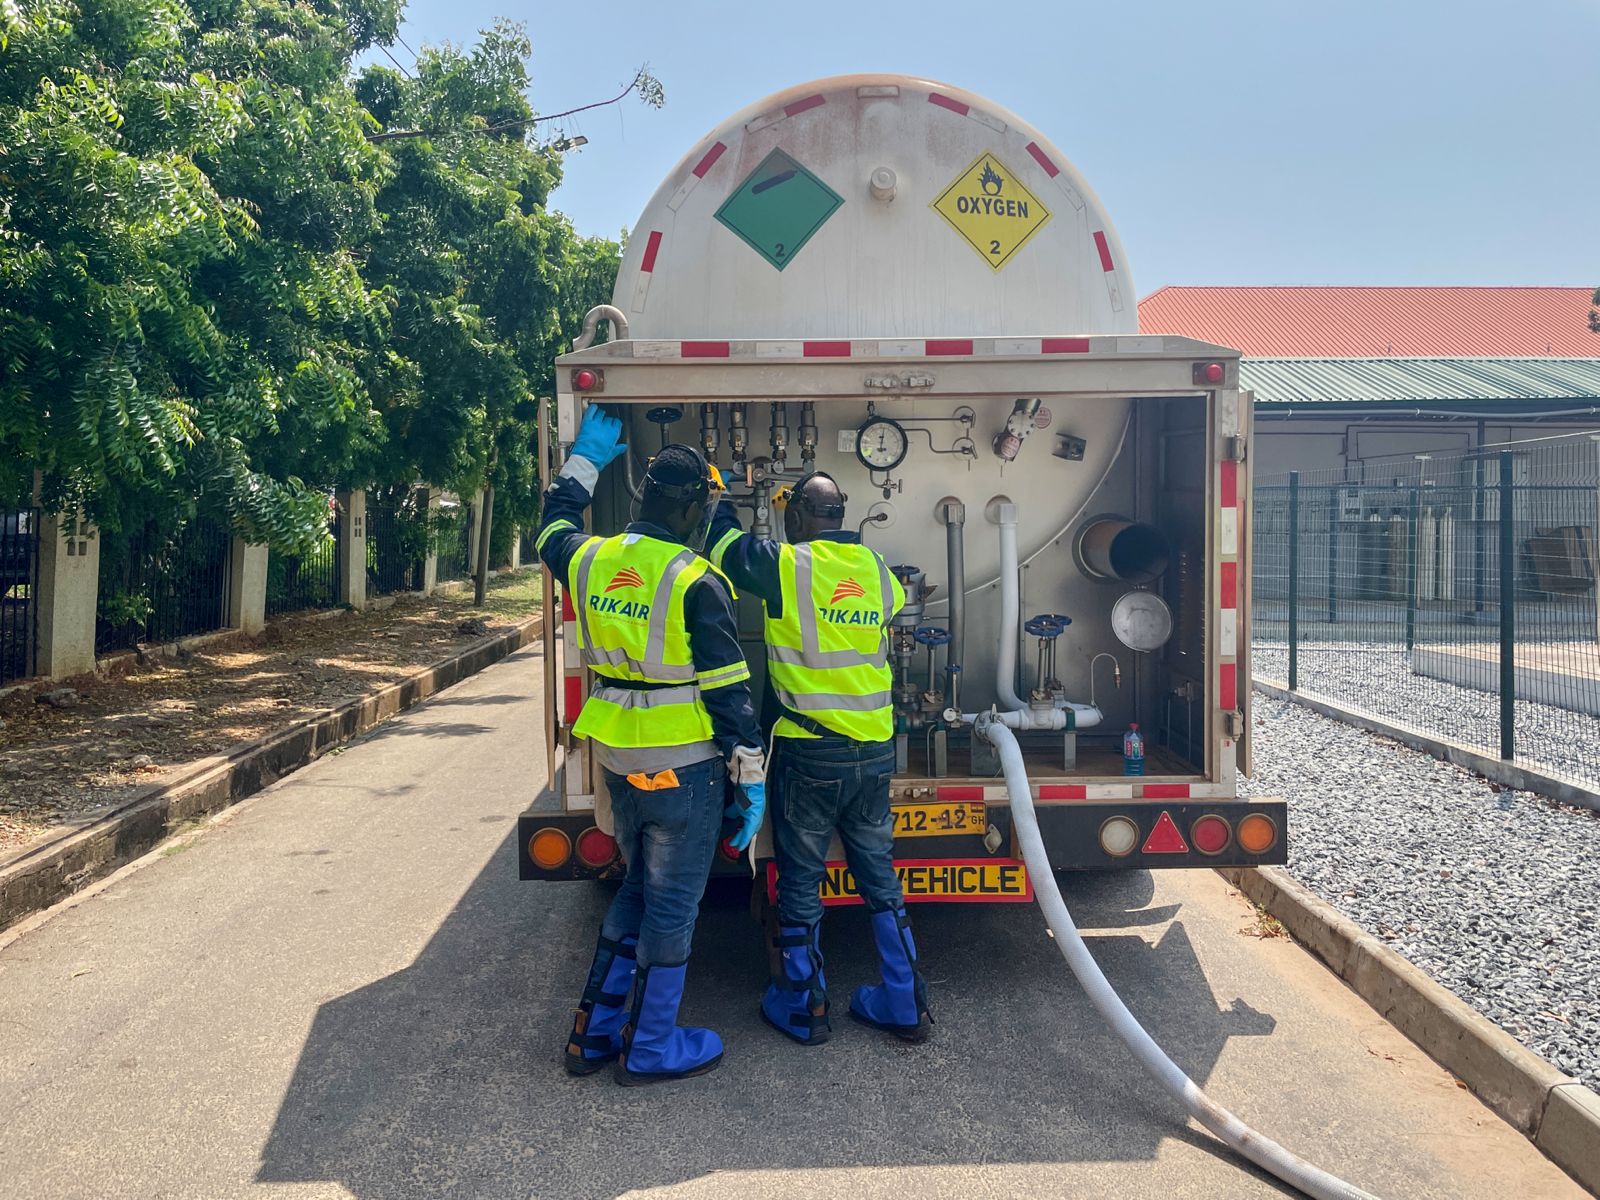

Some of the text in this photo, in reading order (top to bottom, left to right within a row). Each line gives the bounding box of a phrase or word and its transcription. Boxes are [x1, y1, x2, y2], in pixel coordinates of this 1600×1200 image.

[957, 196, 1028, 219] OXYGEN
[775, 243, 785, 257] 2
[990, 240, 1000, 254] 2
[590, 594, 650, 621] RIKAIR
[971, 815, 985, 825] GH
